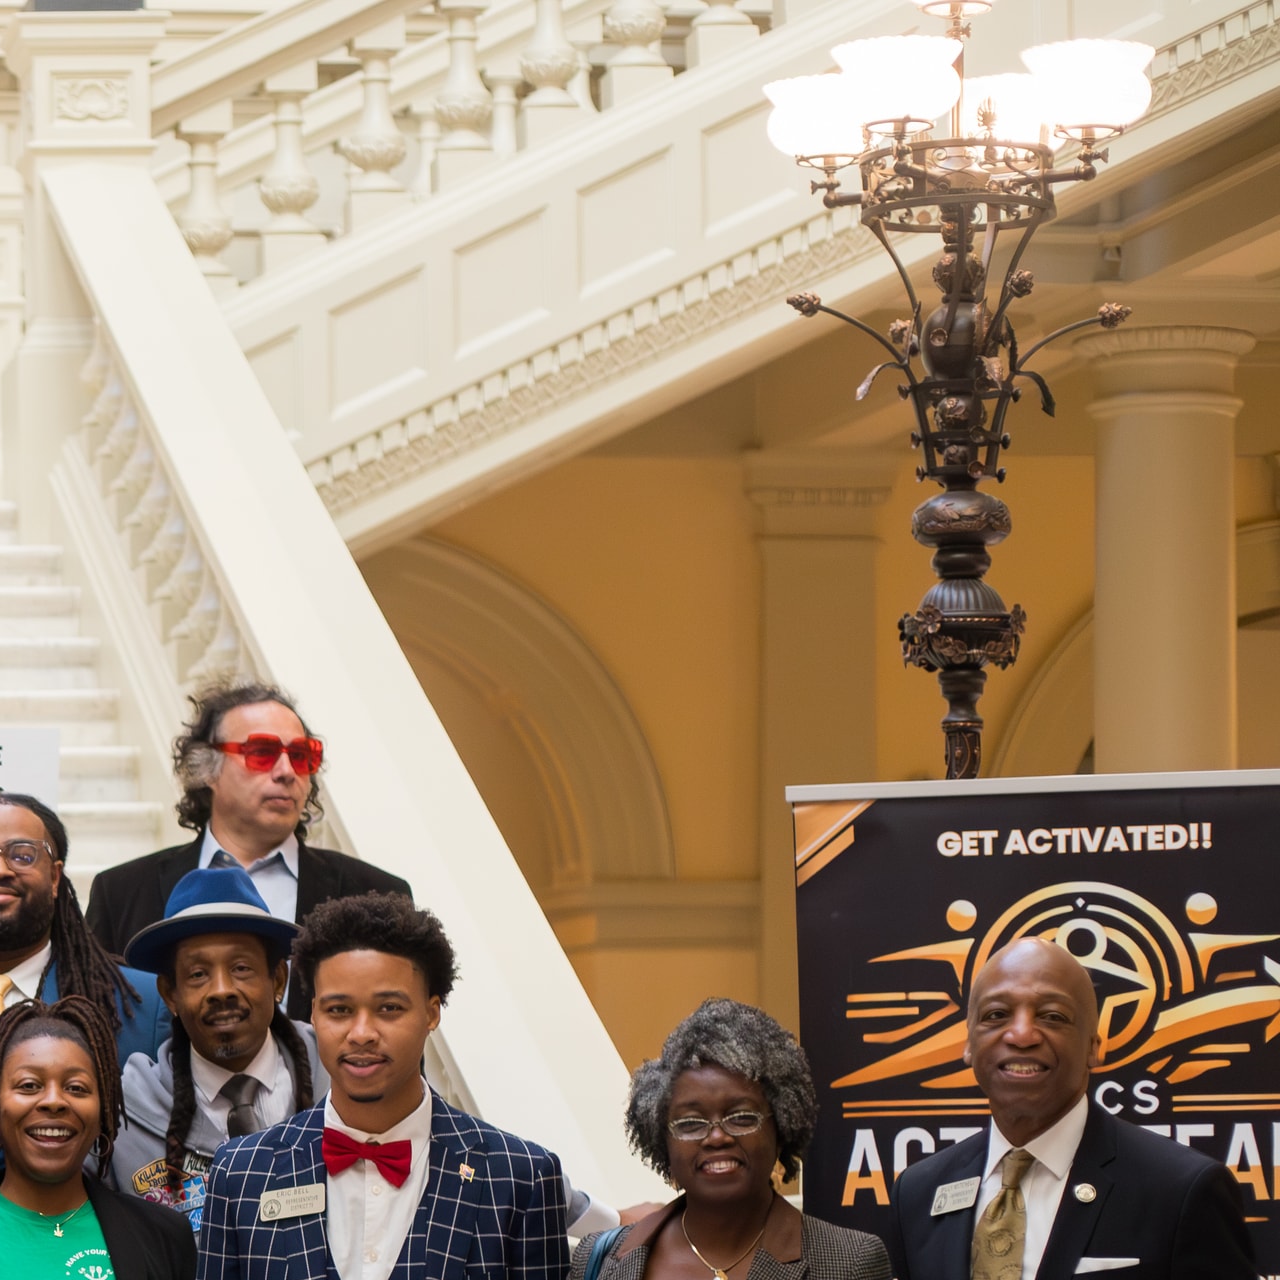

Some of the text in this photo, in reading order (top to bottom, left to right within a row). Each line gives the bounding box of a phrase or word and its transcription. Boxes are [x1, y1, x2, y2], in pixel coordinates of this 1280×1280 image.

[937, 822, 1213, 857] GET ACTIVATED!!
[65, 1248, 107, 1268] HAVE YOUR
